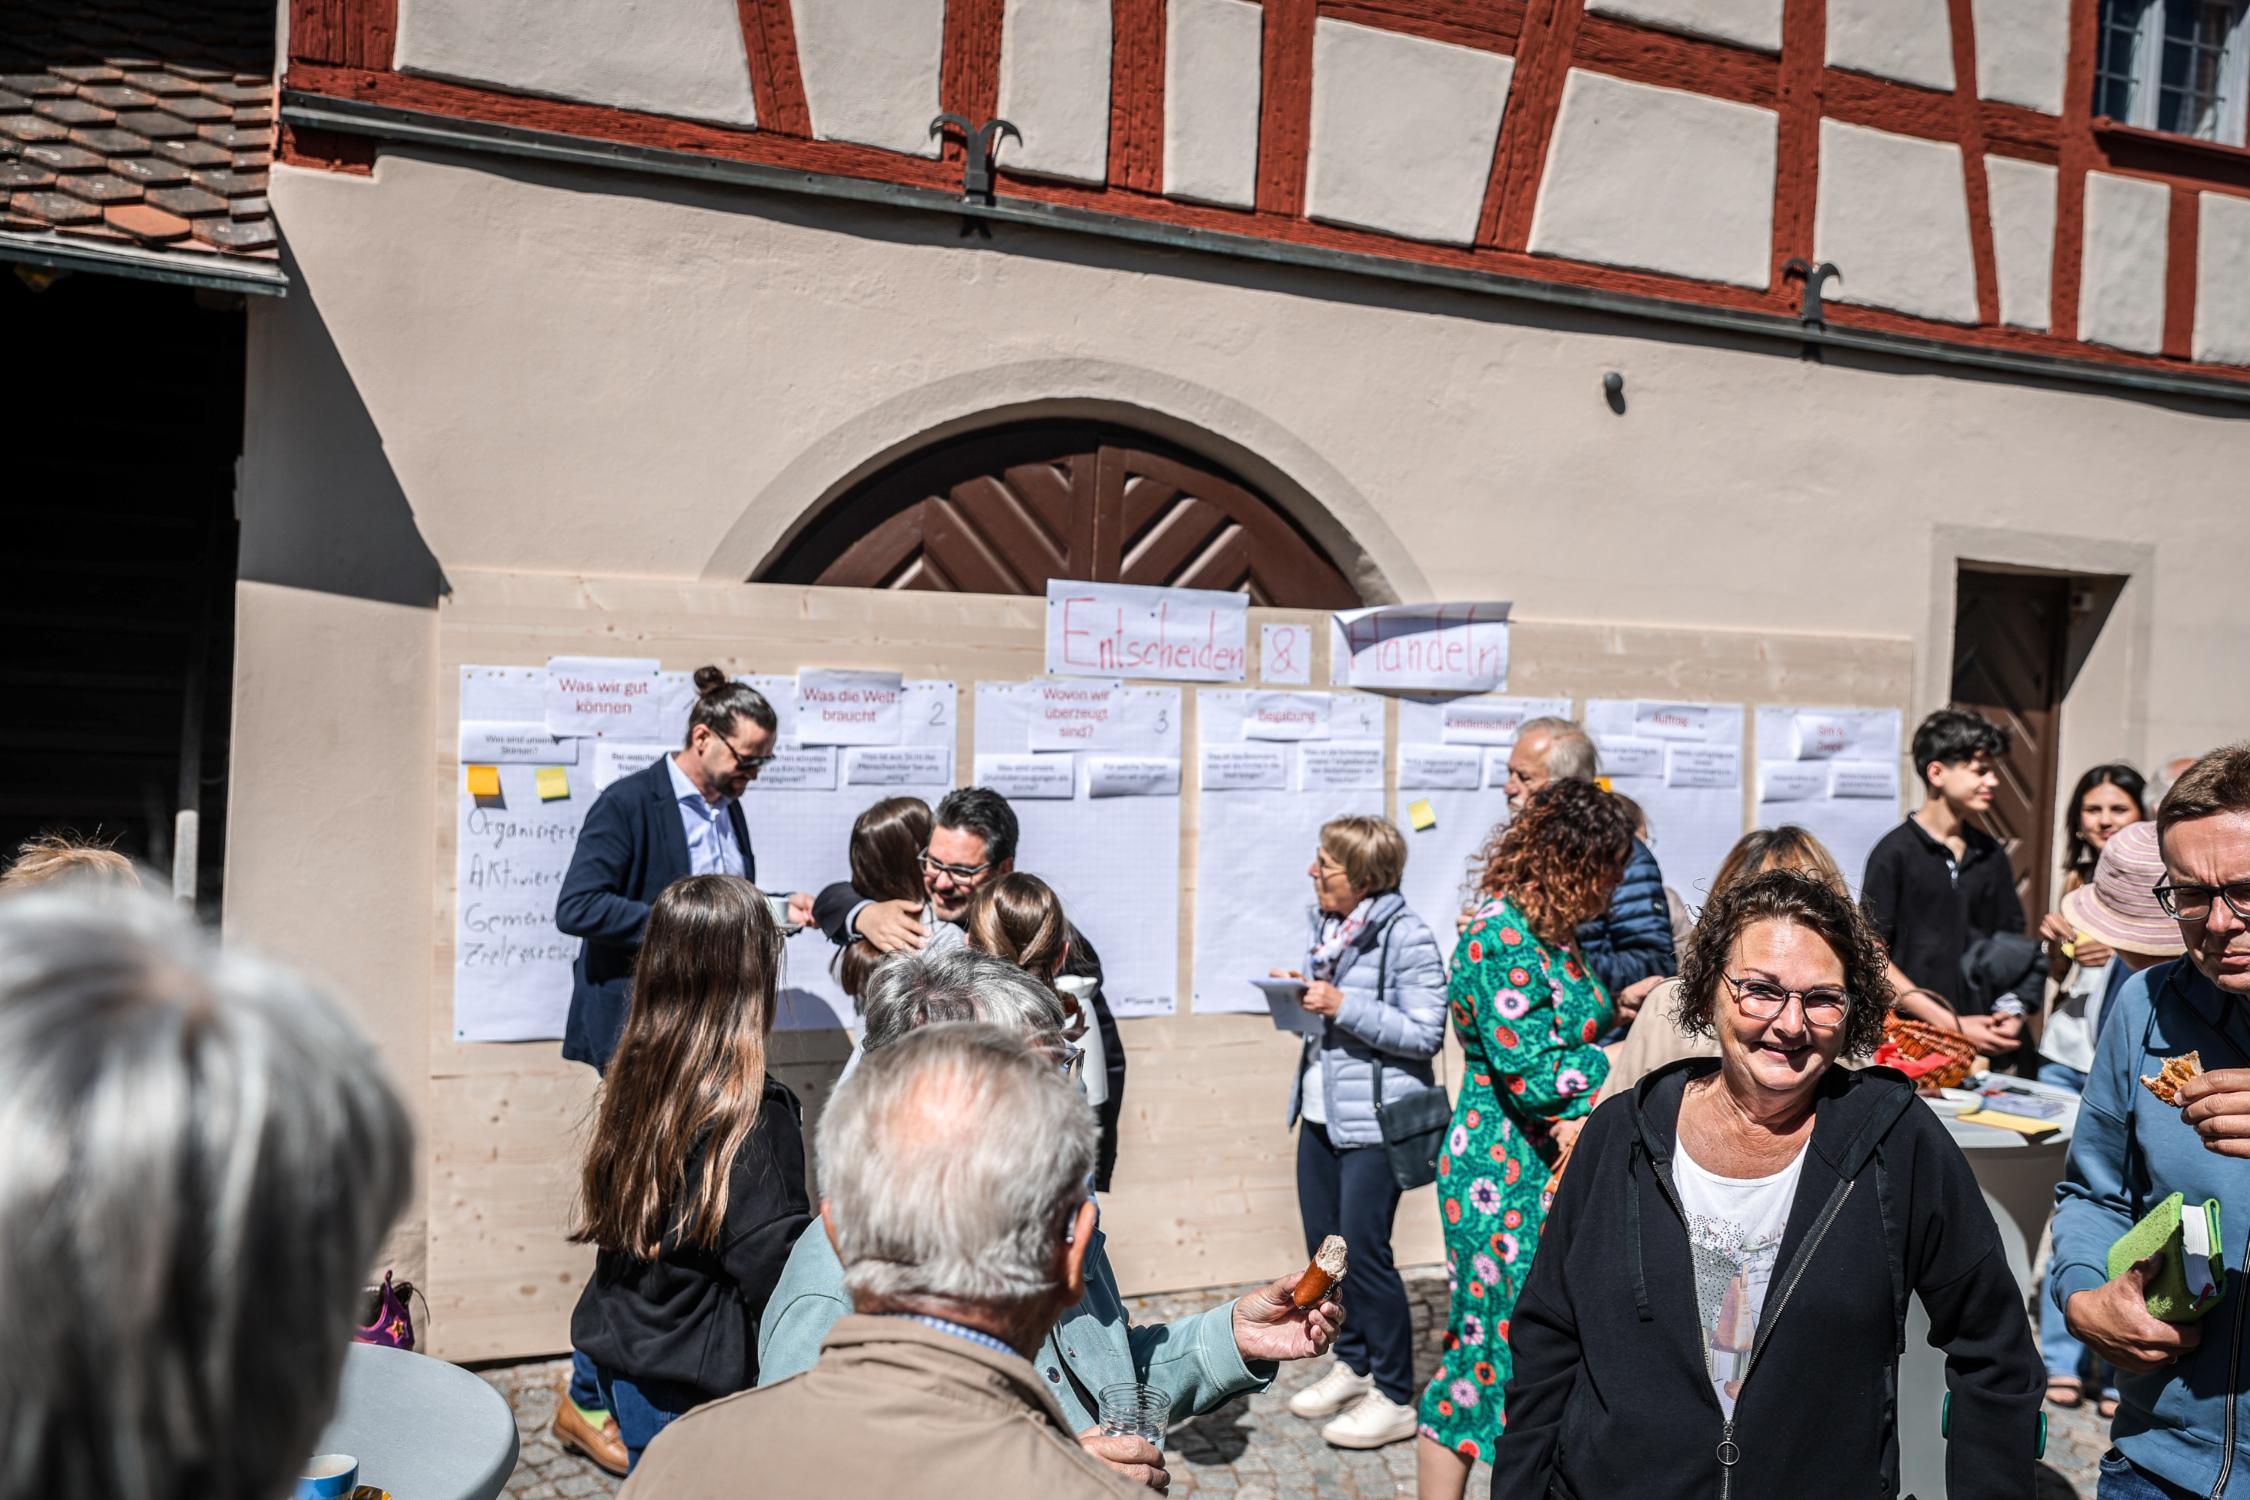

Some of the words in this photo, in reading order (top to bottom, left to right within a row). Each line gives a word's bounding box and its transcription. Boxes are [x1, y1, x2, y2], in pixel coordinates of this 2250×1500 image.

[1063, 597, 1246, 672] Entscheiden
[1270, 627, 1298, 674] &
[1348, 603, 1500, 678] Handeln
[559, 679, 595, 694] Was
[598, 679, 621, 694] wir
[623, 680, 648, 698] gut
[803, 687, 836, 702] Was
[838, 687, 860, 702] die
[862, 687, 896, 704] Welt
[1043, 688, 1089, 701] Wovon
[1091, 688, 1111, 701] wir
[575, 699, 633, 715] können
[928, 701, 947, 727] 2
[1044, 707, 1109, 723] überzeugt
[821, 708, 877, 723] braucht
[1058, 726, 1094, 739] sind?
